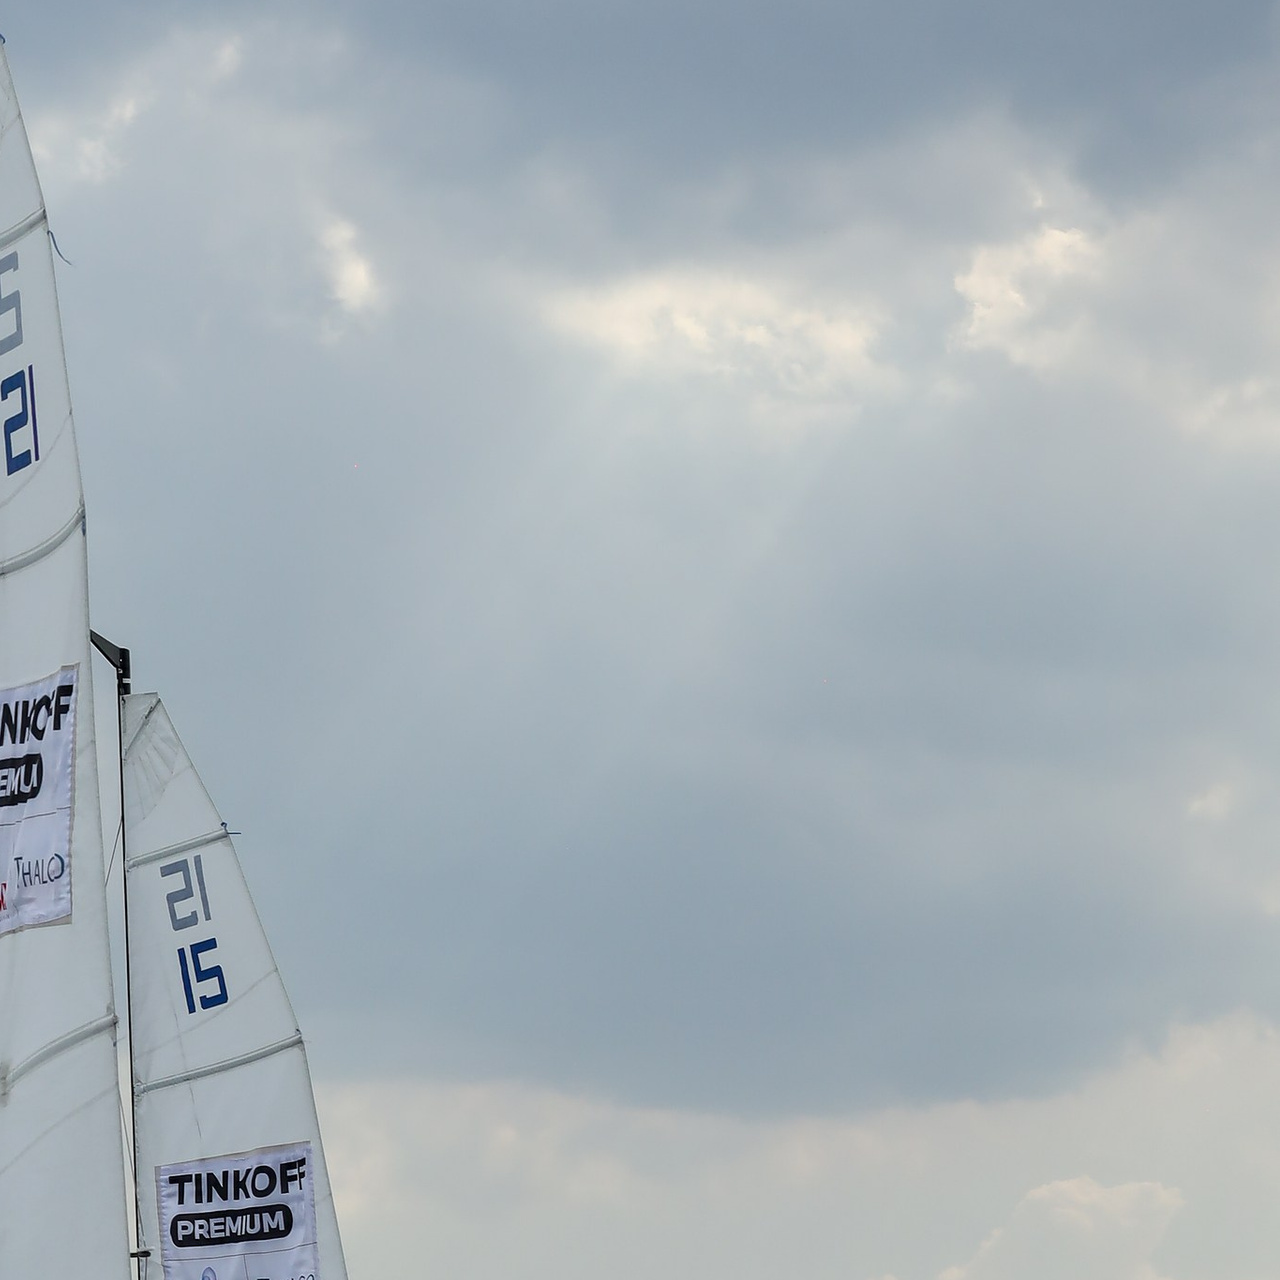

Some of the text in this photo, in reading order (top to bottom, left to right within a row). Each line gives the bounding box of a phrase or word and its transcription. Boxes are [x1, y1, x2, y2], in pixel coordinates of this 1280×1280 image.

[0, 364, 40, 477] 21
[177, 937, 229, 1015] 15
[168, 1156, 307, 1206] TINKOFF
[176, 1210, 286, 1241] PREMIUM
